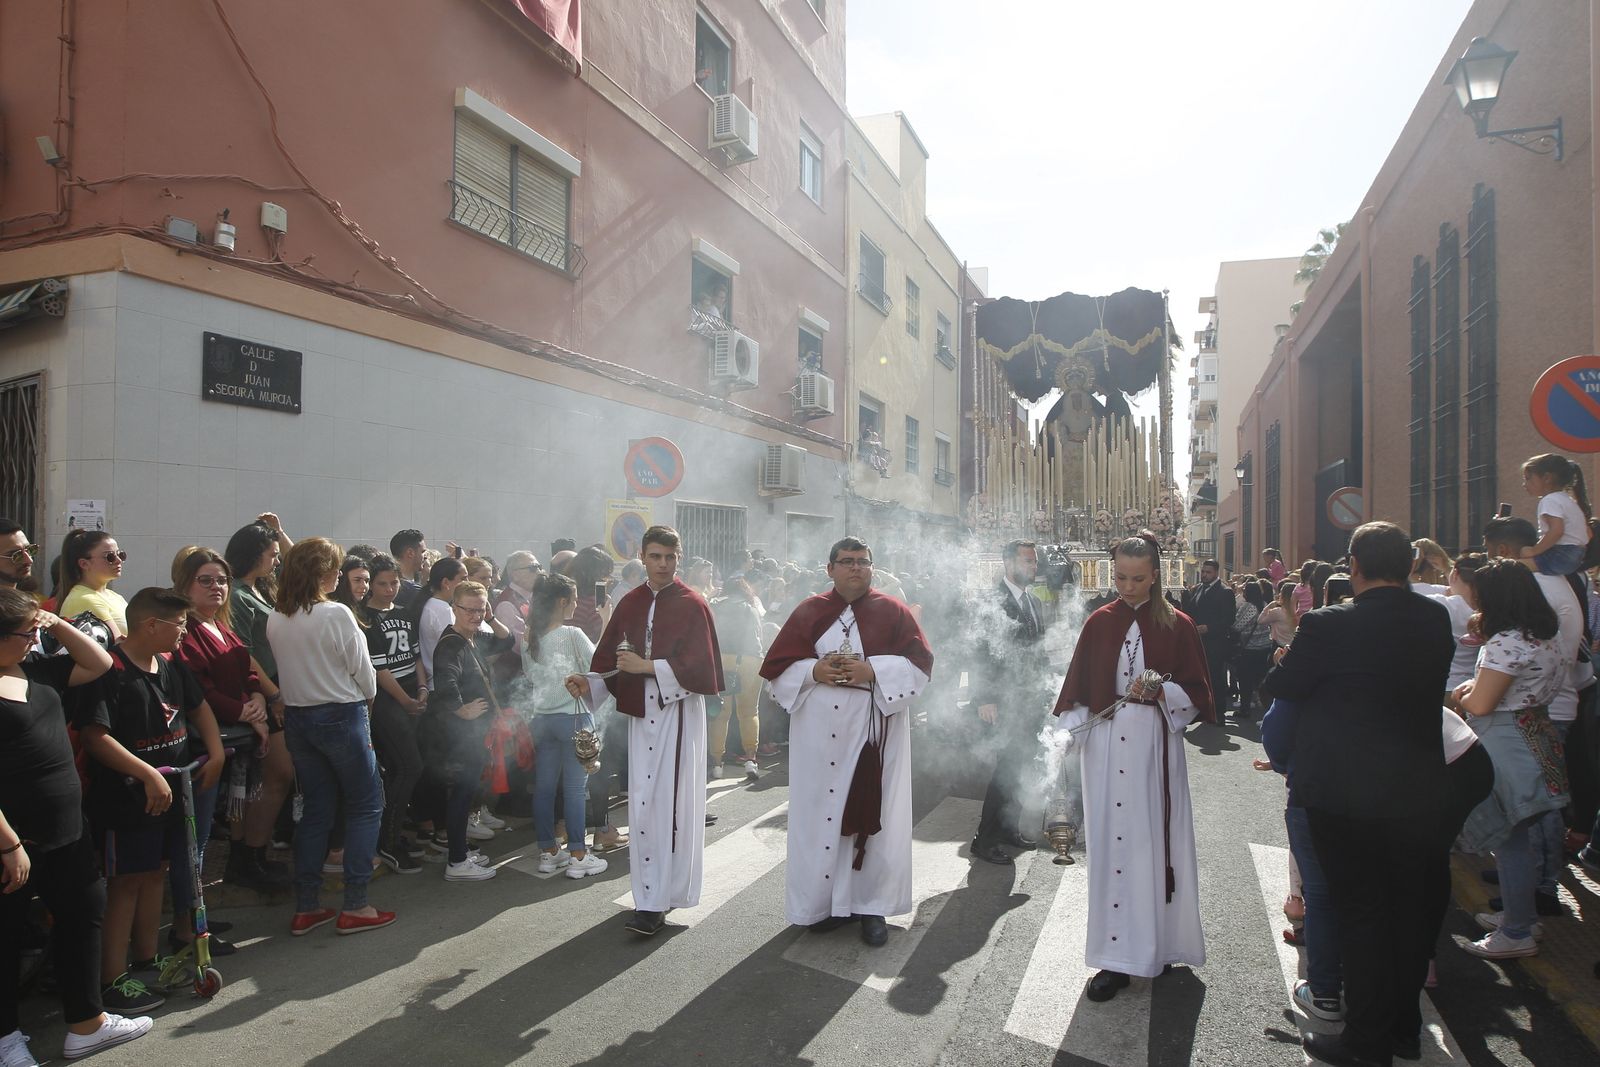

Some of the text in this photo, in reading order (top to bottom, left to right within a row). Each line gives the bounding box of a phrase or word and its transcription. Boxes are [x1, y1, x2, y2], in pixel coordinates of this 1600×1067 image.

[240, 344, 275, 361] CALLE
[249, 360, 258, 371] D
[244, 374, 270, 388] JUAN
[215, 383, 293, 406] SEGURA MURCIA
[381, 619, 412, 632] OREVER
[385, 630, 410, 655] 78
